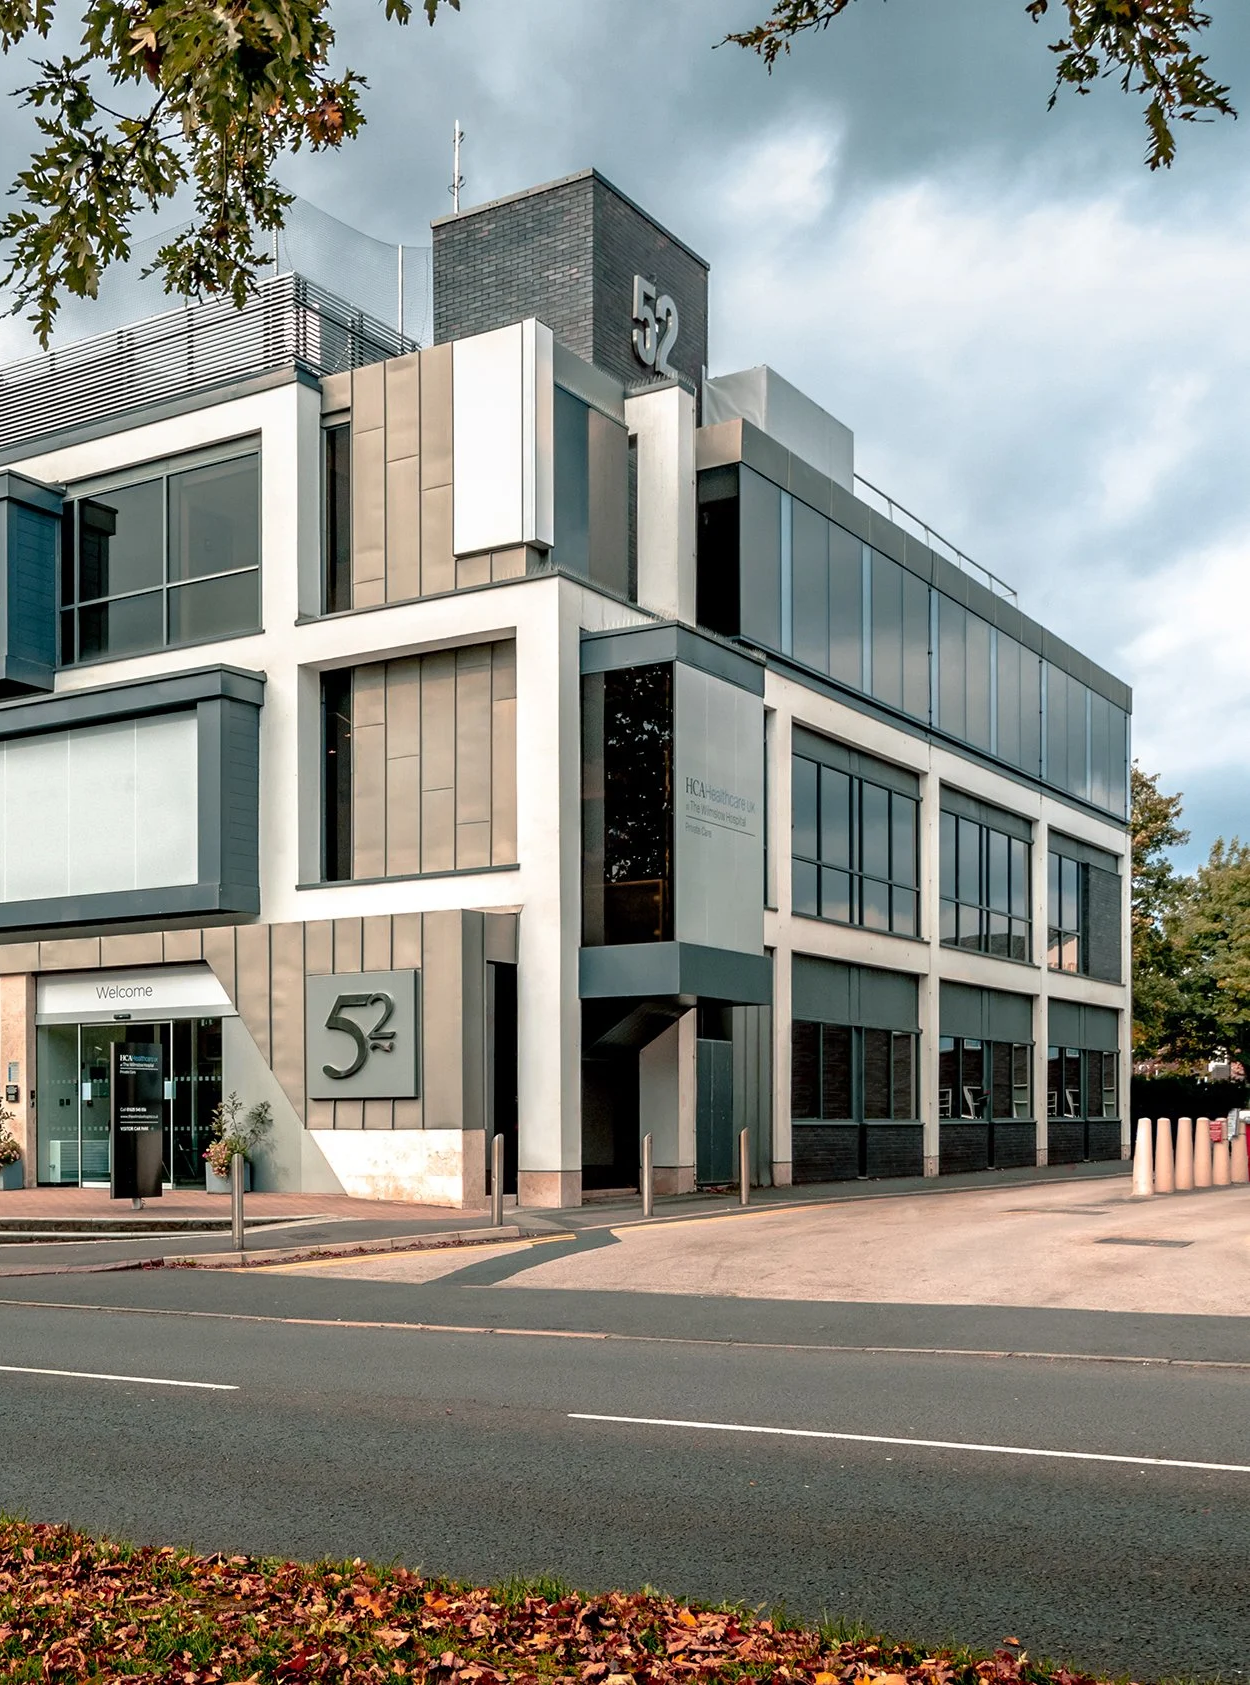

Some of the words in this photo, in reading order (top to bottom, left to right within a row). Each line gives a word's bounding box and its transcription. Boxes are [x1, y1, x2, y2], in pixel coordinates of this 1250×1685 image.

[632, 274, 679, 380] 52
[690, 799, 701, 814] The
[725, 811, 747, 828] Hospital
[95, 985, 153, 999] Welcome
[322, 992, 397, 1080] 52
